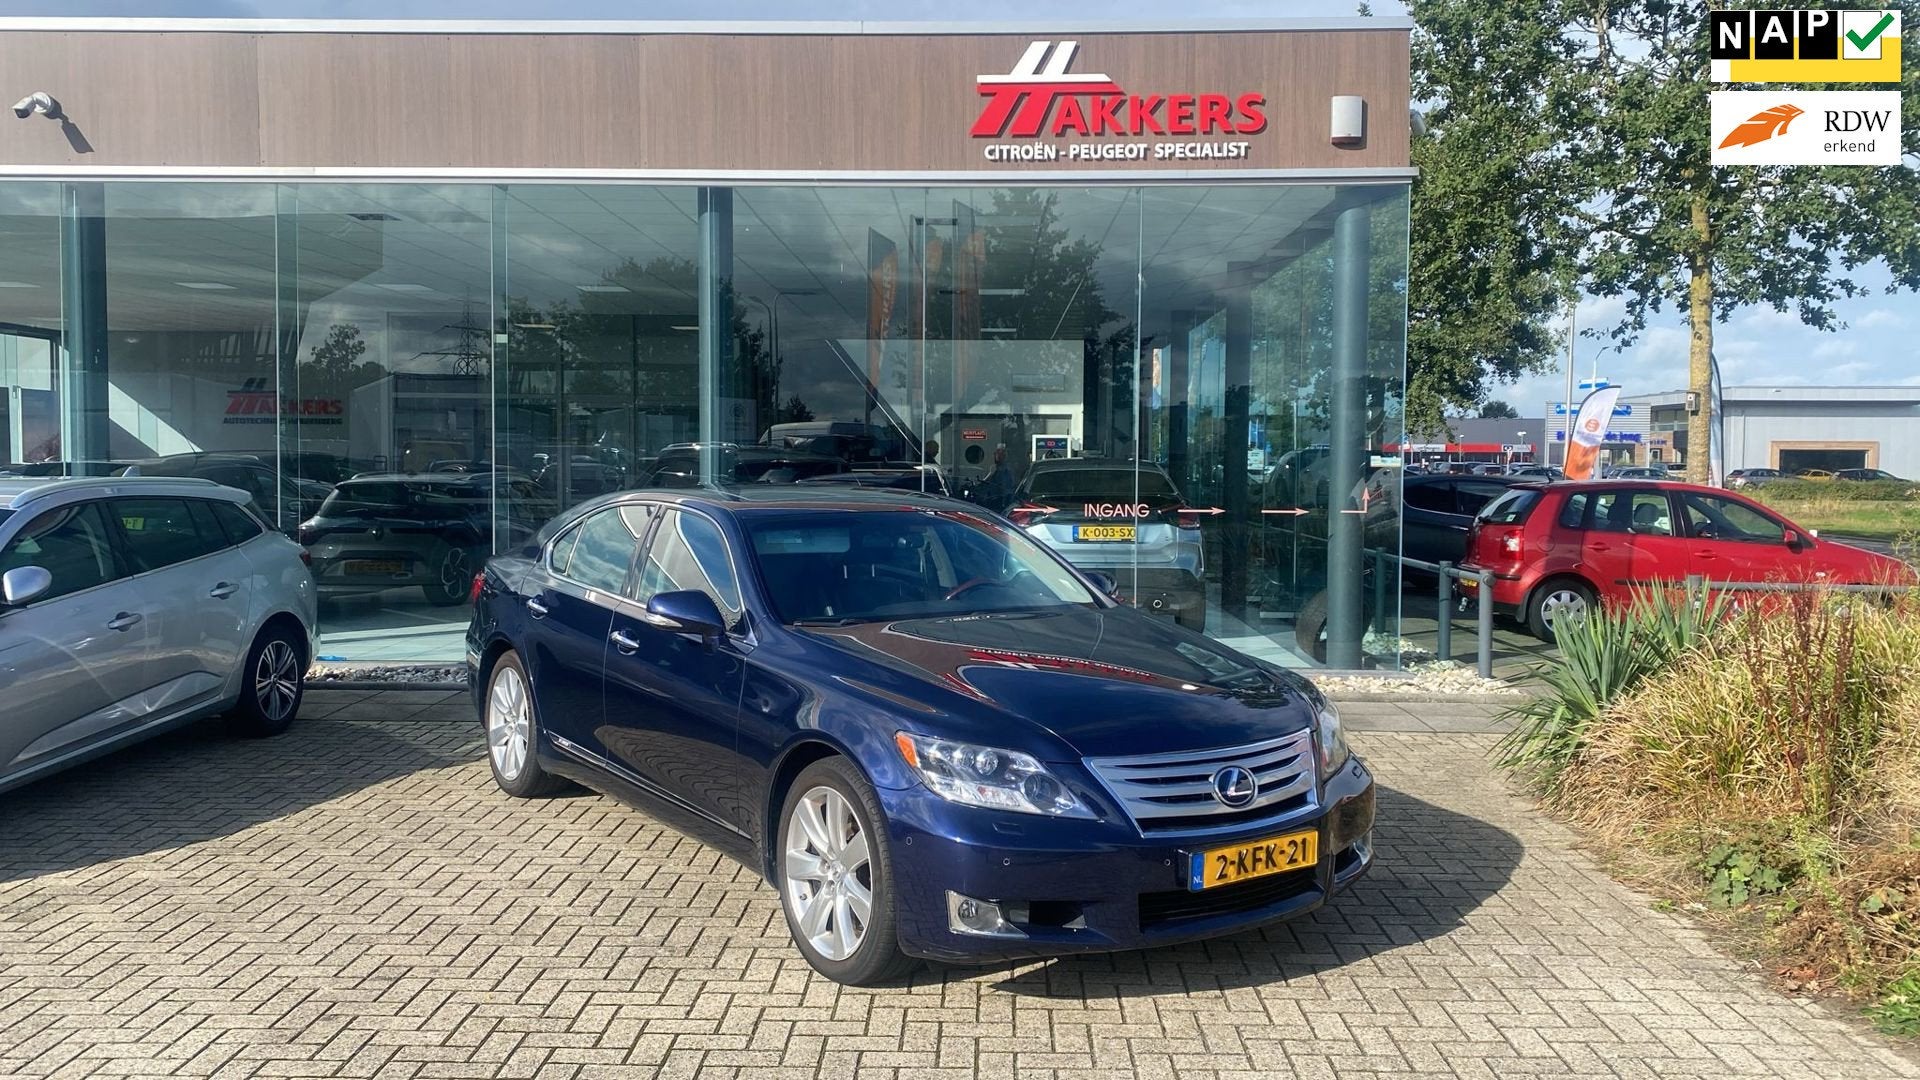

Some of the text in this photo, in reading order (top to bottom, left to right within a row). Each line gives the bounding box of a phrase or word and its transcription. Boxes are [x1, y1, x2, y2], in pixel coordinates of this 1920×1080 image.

[984, 142, 1056, 160] CITROËN
[1069, 143, 1147, 159] PEUGEOT
[1154, 142, 1248, 158] SPECIALIST
[1084, 503, 1150, 517] INGANG
[1215, 837, 1308, 880] 2-KFK-21
